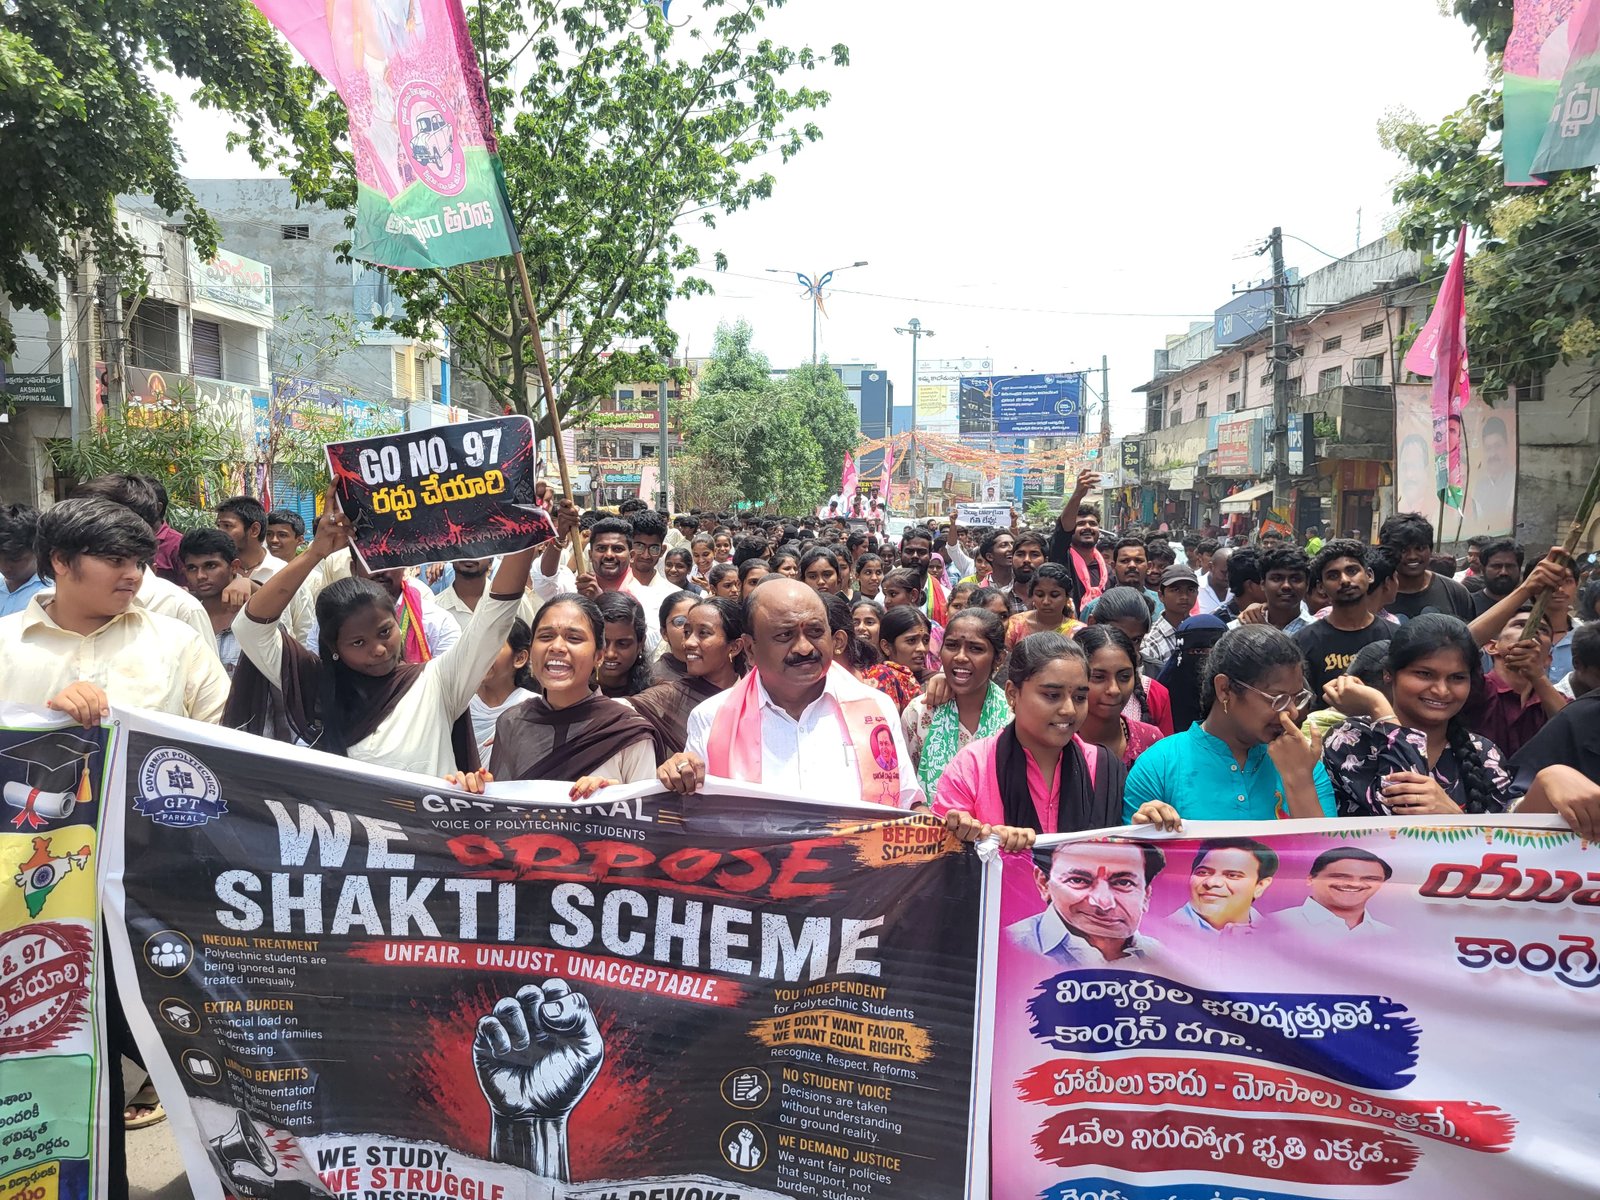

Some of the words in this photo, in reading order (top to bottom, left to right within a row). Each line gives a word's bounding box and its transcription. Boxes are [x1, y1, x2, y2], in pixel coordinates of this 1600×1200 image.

[1223, 314, 1233, 336] SBI
[359, 445, 401, 486] GO
[408, 436, 458, 478] NO.
[463, 427, 503, 468] 97
[372, 484, 417, 522] రద్దు
[420, 469, 506, 506] చేయాలి
[162, 813, 198, 822] PARKAL
[164, 797, 200, 810] GPT
[431, 820, 471, 830] VOICE
[474, 820, 492, 830] OF
[496, 820, 582, 834] POLYTECHNIC
[585, 823, 646, 841] STUDENTS
[264, 799, 416, 871] WE
[446, 833, 847, 899] OPPOSE
[214, 869, 516, 941] SHAKTI
[549, 882, 885, 982] SCHEME
[22, 938, 47, 964] 97
[202, 934, 250, 948] INEQUAL
[252, 938, 319, 952] TREATMENT
[204, 947, 262, 961] Polytechnic
[264, 953, 308, 964] students
[310, 957, 327, 965] are
[204, 961, 235, 973] being
[237, 962, 275, 974] ignored
[277, 966, 296, 976] and
[204, 975, 244, 986] treated
[246, 977, 297, 988] unequally.
[384, 944, 466, 966] UNFAIR.
[476, 948, 560, 973] UNJUST.
[566, 956, 720, 1003] UNACCEPTABLE.
[9, 963, 79, 1005] చేయాలి
[774, 989, 800, 1001] YOU
[803, 981, 887, 1000] INDEPENDENT
[1055, 979, 1194, 1014] విద్యార్థుల
[204, 1001, 242, 1013] EXTRA
[246, 1000, 294, 1012] BURDEN
[257, 1015, 281, 1026] load
[284, 1016, 299, 1026] on
[773, 1004, 790, 1014] for
[793, 995, 859, 1011] Polytechnic
[861, 1001, 915, 1020] Students
[257, 1029, 278, 1041] and
[281, 1028, 323, 1040] families
[773, 1018, 791, 1031] WE
[794, 1014, 829, 1028] DON'T
[832, 1016, 865, 1035] WANT
[867, 1023, 908, 1043] FAVOR,
[1055, 1015, 1167, 1048] కాంగ్రెస్
[1175, 1022, 1263, 1053] దగా..
[772, 1030, 790, 1042] WE
[794, 1028, 828, 1043] WANT
[830, 1032, 866, 1051] EQUAL
[869, 1041, 915, 1059] RIGHTS.
[255, 1066, 309, 1083] BENEFITS
[770, 1048, 824, 1063] Recognize.
[826, 1053, 870, 1072] Respect.
[873, 1062, 919, 1080] Reforms.
[783, 1067, 799, 1081] NO
[802, 1072, 854, 1094] STUDENT
[857, 1083, 892, 1101] VOICE
[271, 1100, 313, 1112] benefits
[782, 1083, 833, 1104] Decisions
[835, 1097, 854, 1108] are
[856, 1100, 888, 1115] taken
[1053, 1065, 1144, 1098] హామీలు
[1147, 1068, 1207, 1098] కాదు
[1233, 1071, 1342, 1109] మోసాలు
[1348, 1096, 1472, 1144] మాత్రమే..
[779, 1114, 798, 1125] our
[800, 1118, 840, 1133] ground
[842, 1126, 880, 1143] reality.
[781, 1099, 820, 1116] without
[823, 1109, 902, 1135] understanding
[317, 1145, 356, 1171] WE
[366, 1145, 452, 1172] STUDY.
[778, 1134, 796, 1149] WE
[800, 1138, 849, 1160] DEMAND
[852, 1151, 901, 1172] JUSTICE
[1058, 1117, 1125, 1148] 4వేల
[1131, 1124, 1246, 1160] నిరుద్యోగ
[1252, 1135, 1307, 1169] భృతి
[1313, 1138, 1398, 1171] ఎక్కడ..
[777, 1164, 800, 1178] that
[803, 1171, 849, 1191] support,
[852, 1182, 872, 1194] not
[778, 1150, 795, 1163] We
[798, 1156, 825, 1170] want
[828, 1160, 846, 1175] fair
[849, 1167, 892, 1185] policies
[319, 1167, 361, 1192] WE
[371, 1167, 505, 1200] STRUGGLE
[776, 1177, 819, 1198] burden,
